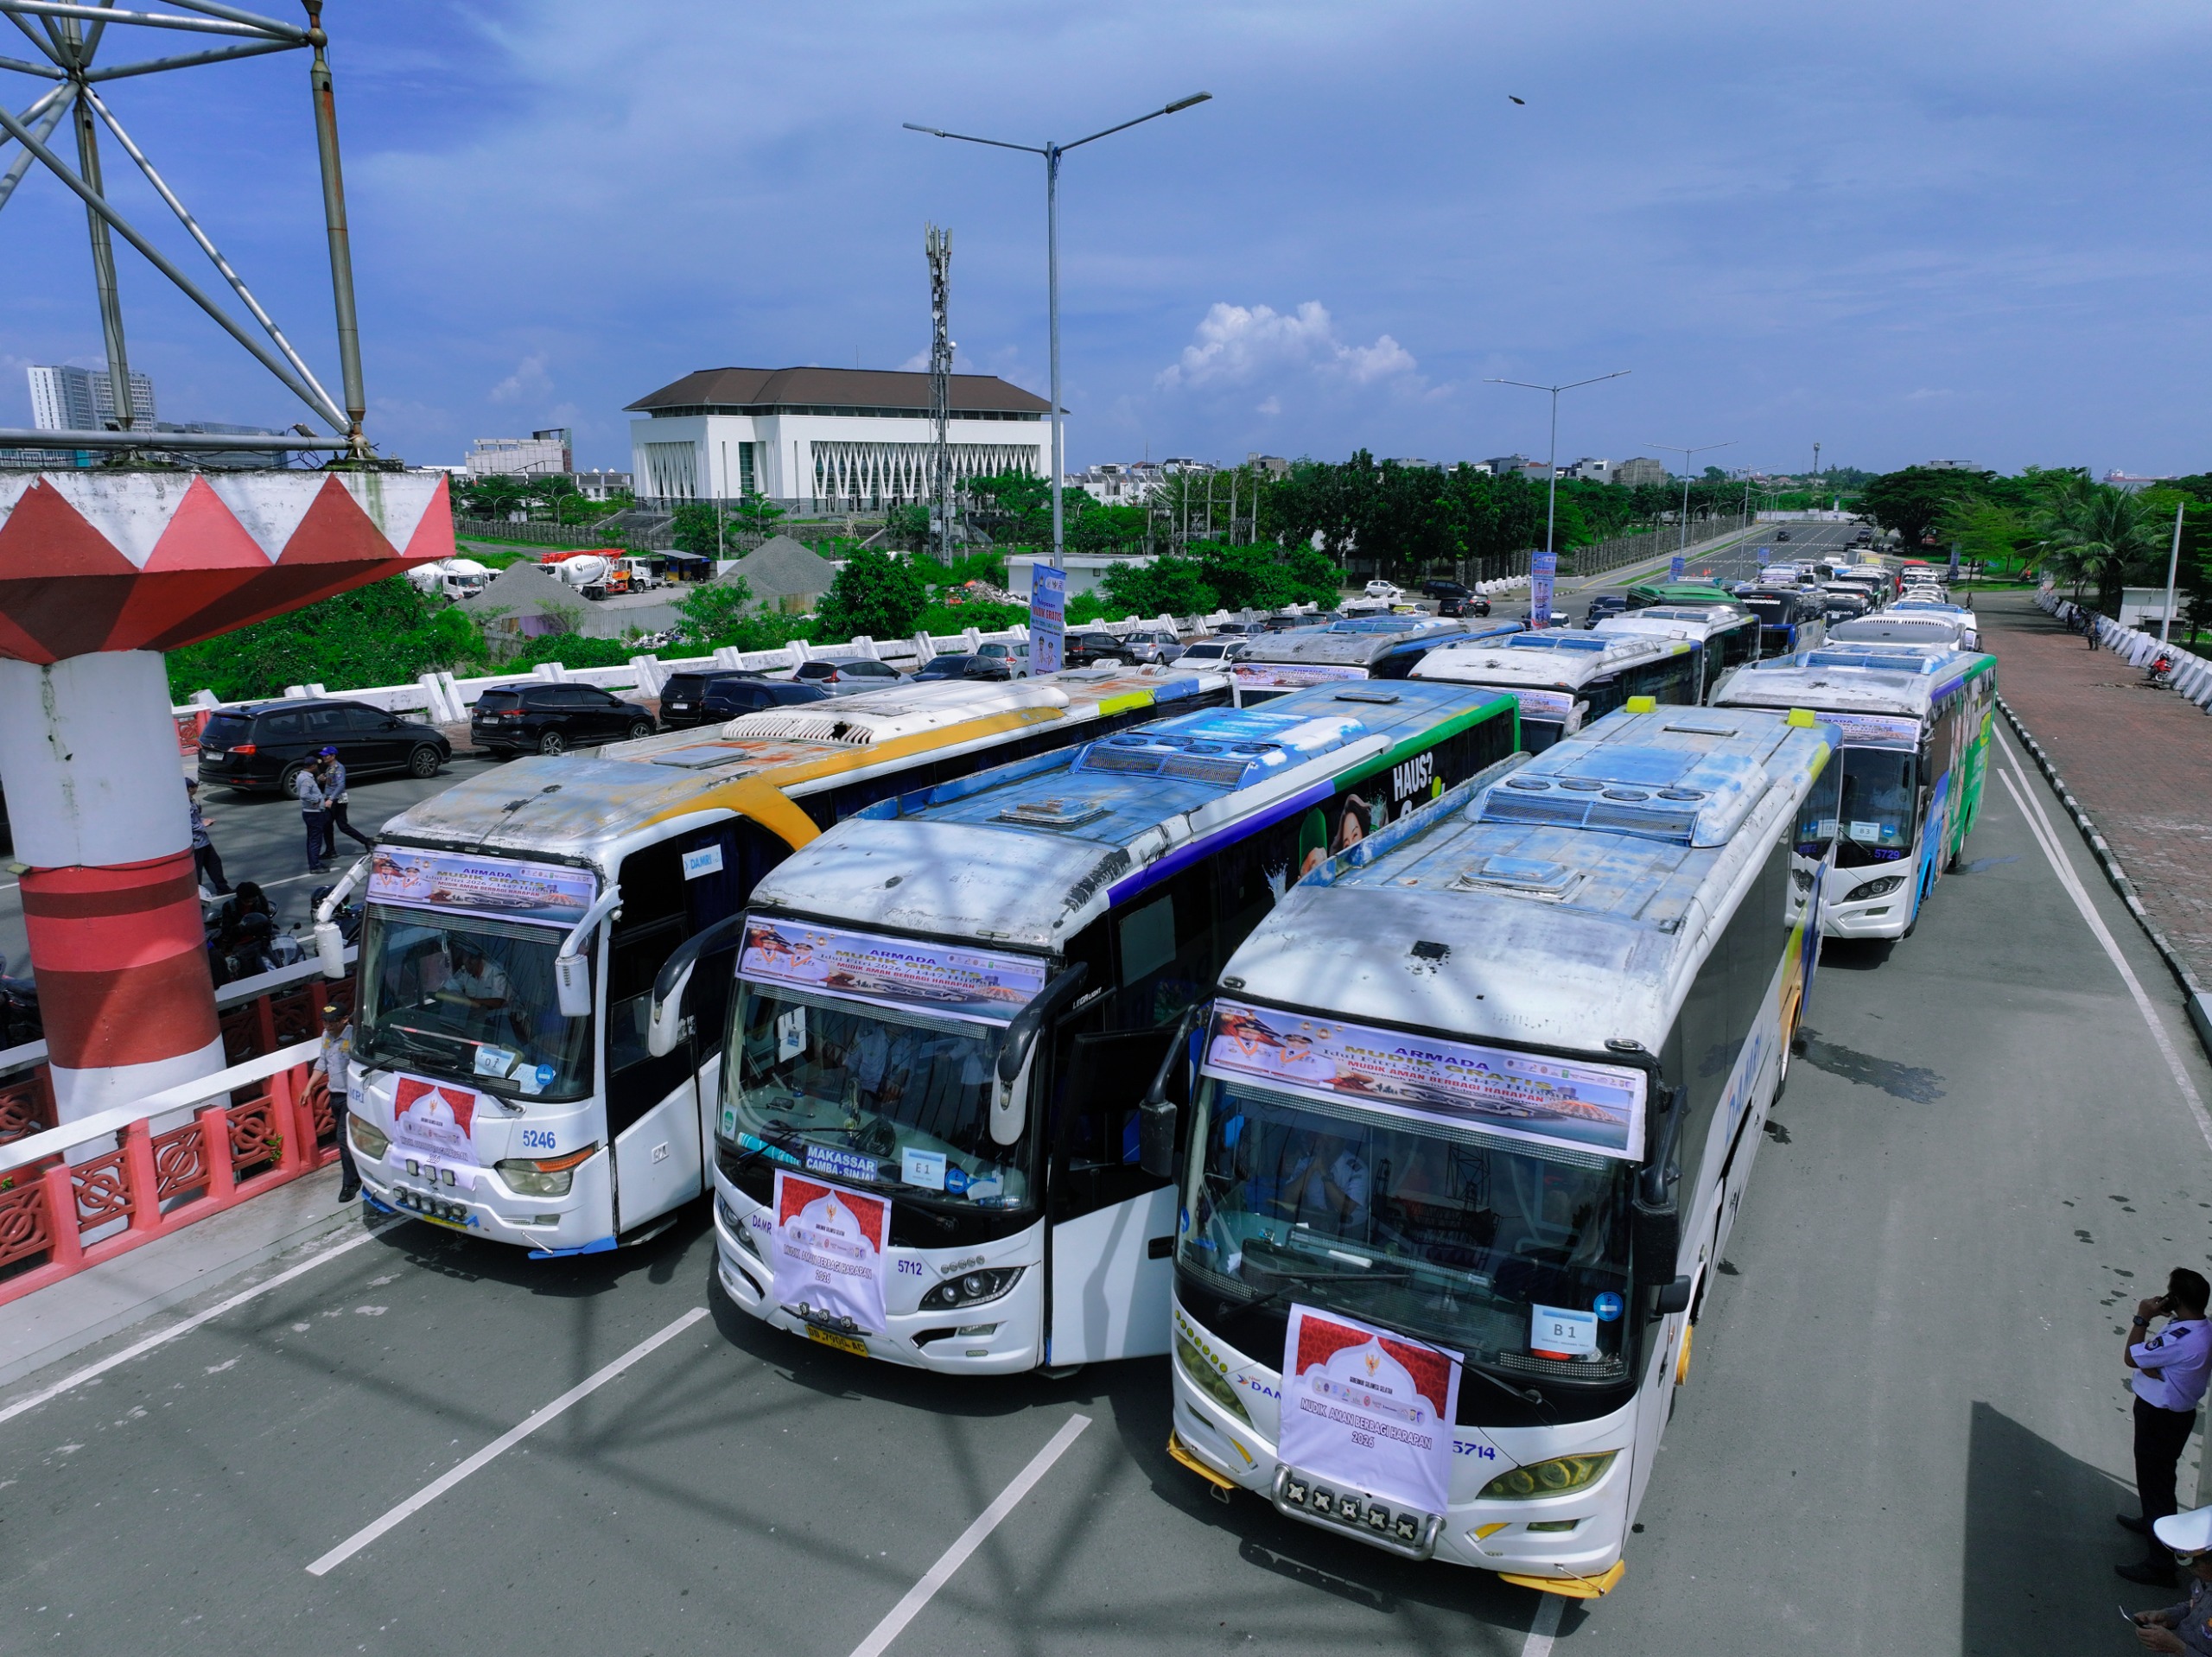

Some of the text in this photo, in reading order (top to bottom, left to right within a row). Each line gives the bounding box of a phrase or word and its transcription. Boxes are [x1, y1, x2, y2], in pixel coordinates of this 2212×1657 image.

[1393, 752, 1433, 803] HAUS?
[690, 853, 713, 870] DAMRI
[1873, 848, 1900, 860] 5729
[436, 870, 545, 888] MUDIK GRATIS
[462, 867, 513, 879] ARMADA
[820, 953, 843, 962] Idul
[846, 958, 872, 967] Fitri
[874, 962, 902, 972] 2026
[916, 969, 944, 978] 1447
[835, 949, 982, 980] MUDIK GRATIS
[870, 949, 937, 965] ARMADA
[836, 962, 864, 971] MUDIK
[866, 967, 891, 975] AMAN
[932, 978, 976, 989] HARAPAN
[1323, 1048, 1355, 1060] Idul
[1361, 1056, 1397, 1068] Fitri
[1402, 1063, 1440, 1076] 2026
[1461, 1075, 1500, 1087] 1447
[1344, 1045, 1554, 1091] MUDIK GRATIS
[1394, 1046, 1491, 1071] ARMADA
[1347, 1060, 1544, 1102] MUDIK AMAN BERBAGI HARAPAN
[523, 1129, 556, 1149] 5246
[806, 1158, 838, 1175] CAMBA
[807, 1146, 875, 1172] MAKASSAR
[916, 1162, 931, 1175] E 1
[753, 1214, 772, 1235] DAMR
[815, 1269, 831, 1284] 2026
[842, 1263, 873, 1279] HARAPAN
[898, 1259, 922, 1276] 5712
[1554, 1324, 1576, 1338] B 1
[1300, 1397, 1433, 1451] MUDIK AMAN BERBAGI HARAPAN
[1351, 1431, 1375, 1449] 2026
[1452, 1440, 1496, 1461] 5714
